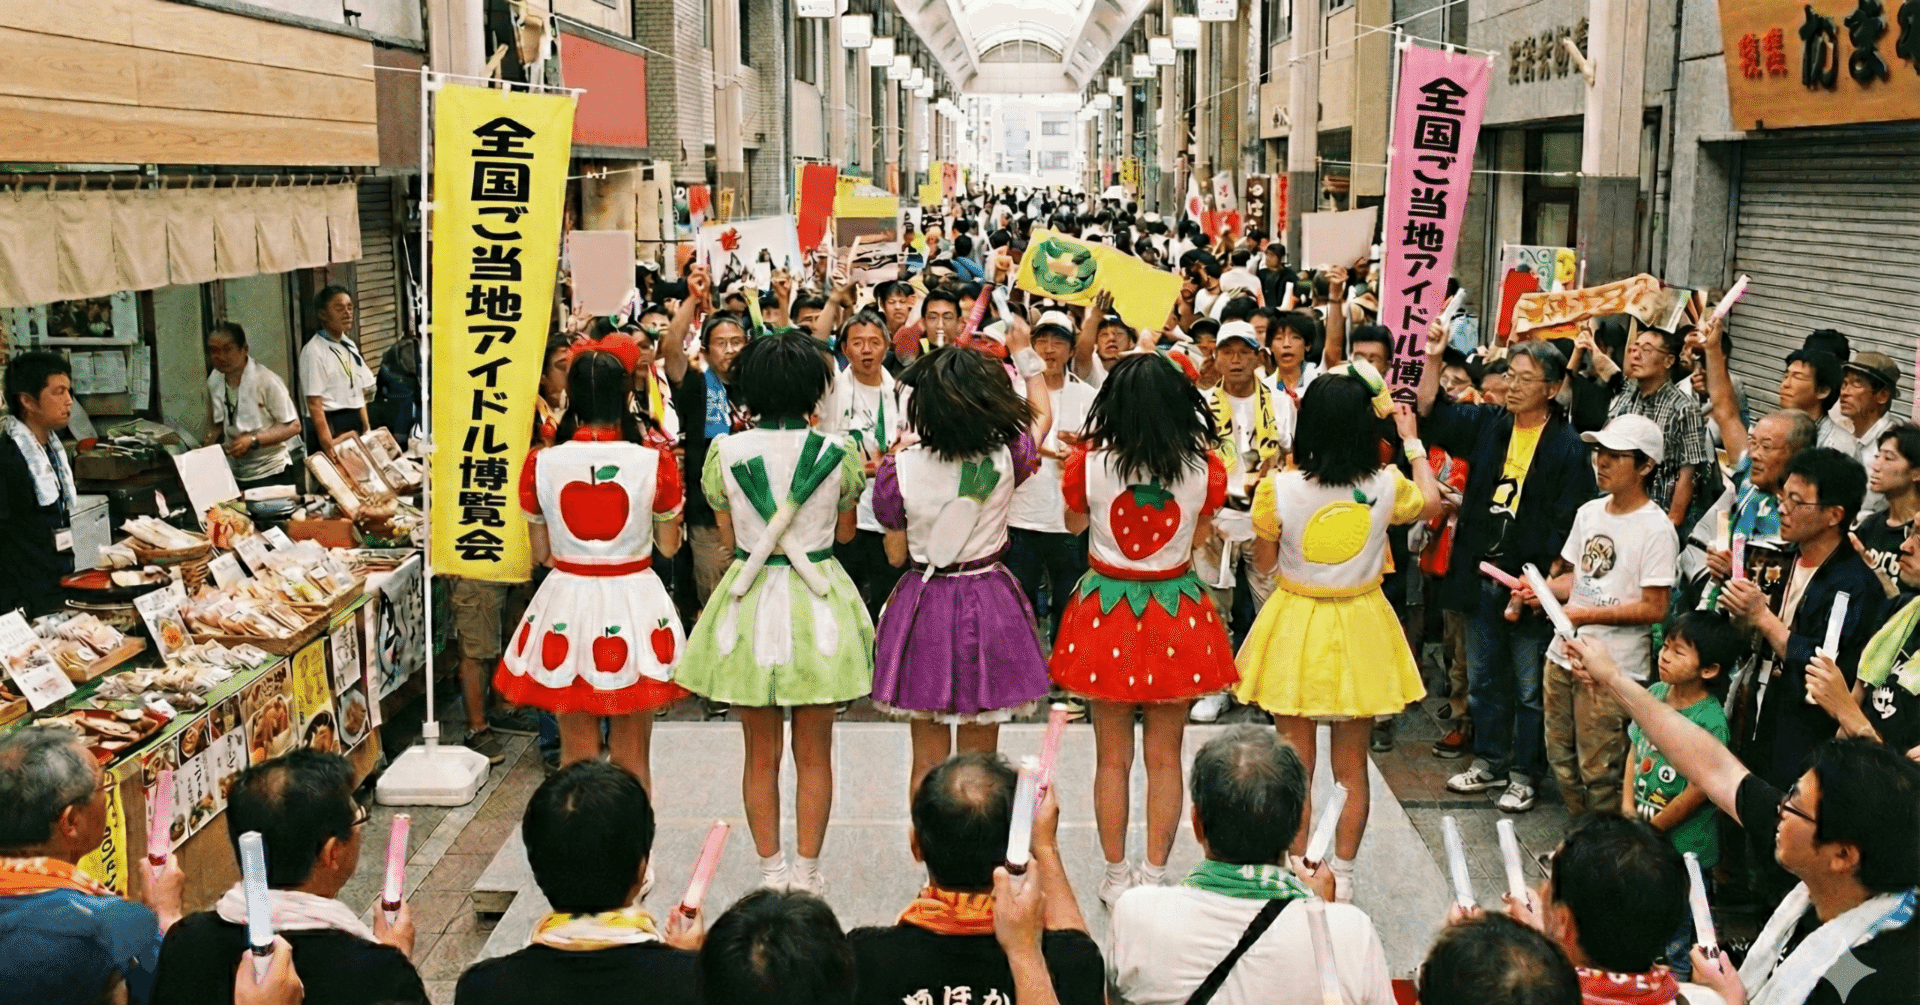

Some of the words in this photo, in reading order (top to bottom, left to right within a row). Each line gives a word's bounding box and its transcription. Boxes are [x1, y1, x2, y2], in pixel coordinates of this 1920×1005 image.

[454, 116, 536, 563] 全国ご当地アイドル博覧会
